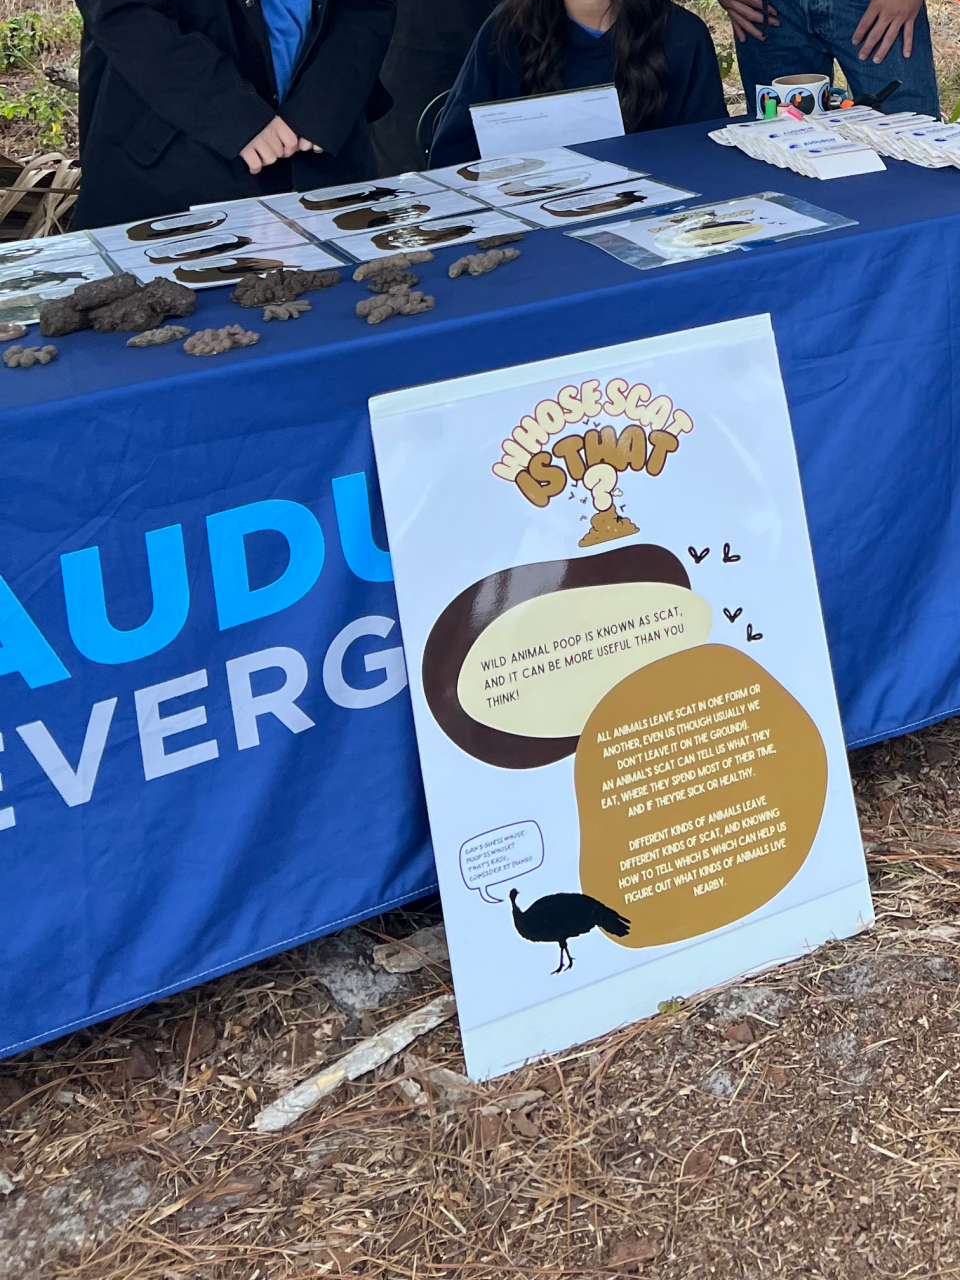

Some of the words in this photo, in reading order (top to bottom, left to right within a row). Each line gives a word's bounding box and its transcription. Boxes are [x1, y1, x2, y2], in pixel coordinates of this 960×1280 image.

[803, 137, 836, 146] AUDUBON
[492, 379, 603, 482] WHOSE
[602, 377, 694, 437] SCAT
[515, 451, 567, 508] IS
[552, 424, 679, 481] THAT
[582, 462, 618, 513] ?
[481, 656, 507, 671] WILD
[511, 644, 550, 664] ANIMAL
[553, 634, 581, 652] POOP
[584, 631, 594, 642] IS
[596, 619, 635, 639] KNOWN
[639, 614, 651, 627] AS
[653, 606, 683, 622] SCAT,
[484, 675, 505, 690] AND
[508, 671, 518, 683] IT
[522, 663, 545, 678] CAN
[548, 659, 561, 672] BE
[564, 649, 594, 667] MORE
[596, 639, 631, 657] USEFUL
[634, 630, 661, 646] THAN
[663, 623, 684, 637] YOU
[486, 689, 520, 708] THINK!
[597, 730, 612, 743] ALL
[613, 719, 649, 738] ANIMALS
[649, 710, 674, 727] LEAVE
[675, 703, 697, 718] SCAT
[698, 700, 706, 712] IN
[707, 694, 725, 709] ONE
[725, 687, 748, 703] FORM
[749, 683, 761, 694] OR
[603, 737, 643, 758] ANOTHER,
[643, 731, 664, 746] EVEN
[664, 726, 676, 738] US
[676, 715, 713, 735] (THOUGH
[713, 704, 746, 723] USUALLY
[747, 699, 761, 712] WE
[600, 794, 621, 809] EAT,
[620, 784, 649, 803] WHERE
[649, 777, 670, 793] THEY
[671, 769, 697, 786] SPEND
[697, 761, 721, 778] MOST
[721, 757, 733, 769] OF
[734, 750, 756, 766] THEIR
[756, 743, 777, 758] TIME,
[602, 779, 615, 793] AN
[616, 767, 653, 788] ANIMAL'S
[653, 759, 675, 775] SCAT
[676, 753, 696, 767] CAN
[696, 747, 715, 762] TELL
[715, 743, 726, 755] US
[726, 735, 750, 751] WHAT
[751, 728, 771, 743] THEY
[617, 753, 643, 770] DON'T
[644, 744, 670, 762] LEAVE
[670, 742, 678, 753] IT
[680, 737, 693, 750] ON
[693, 732, 709, 746] THE
[628, 803, 645, 818] AND
[646, 800, 653, 811] IF
[654, 789, 686, 808] THEY'RE
[687, 785, 706, 798] SICK
[706, 778, 719, 791] OR
[719, 767, 756, 787] HEALTHY.
[629, 828, 669, 851] DIFFERENT
[670, 820, 694, 837] KINDS
[694, 815, 706, 828] OF
[708, 804, 742, 824] ANIMALS
[742, 795, 767, 812] LEAVE
[618, 872, 640, 890] HOW
[641, 868, 654, 881] TO
[655, 861, 674, 876] TELL
[674, 851, 702, 869] WHICH
[702, 848, 710, 860] IS
[711, 838, 738, 856] WHICH
[738, 832, 757, 847] CAN
[757, 825, 776, 840] HELP
[776, 821, 787, 833] US
[619, 848, 660, 872] DIFFERENT
[662, 840, 685, 857] KINDS
[686, 835, 698, 848] OF
[699, 827, 723, 844] SCAT,
[724, 821, 741, 835] AND
[741, 807, 780, 829] KNOWING
[624, 885, 654, 905] FIGURE
[655, 878, 672, 893] OUT
[673, 869, 698, 887] WHAT
[699, 861, 722, 878] KINDS
[723, 856, 734, 869] OF
[736, 844, 770, 865] ANIMALS
[770, 837, 787, 852] LIVE
[693, 876, 727, 897] NEARBY.
